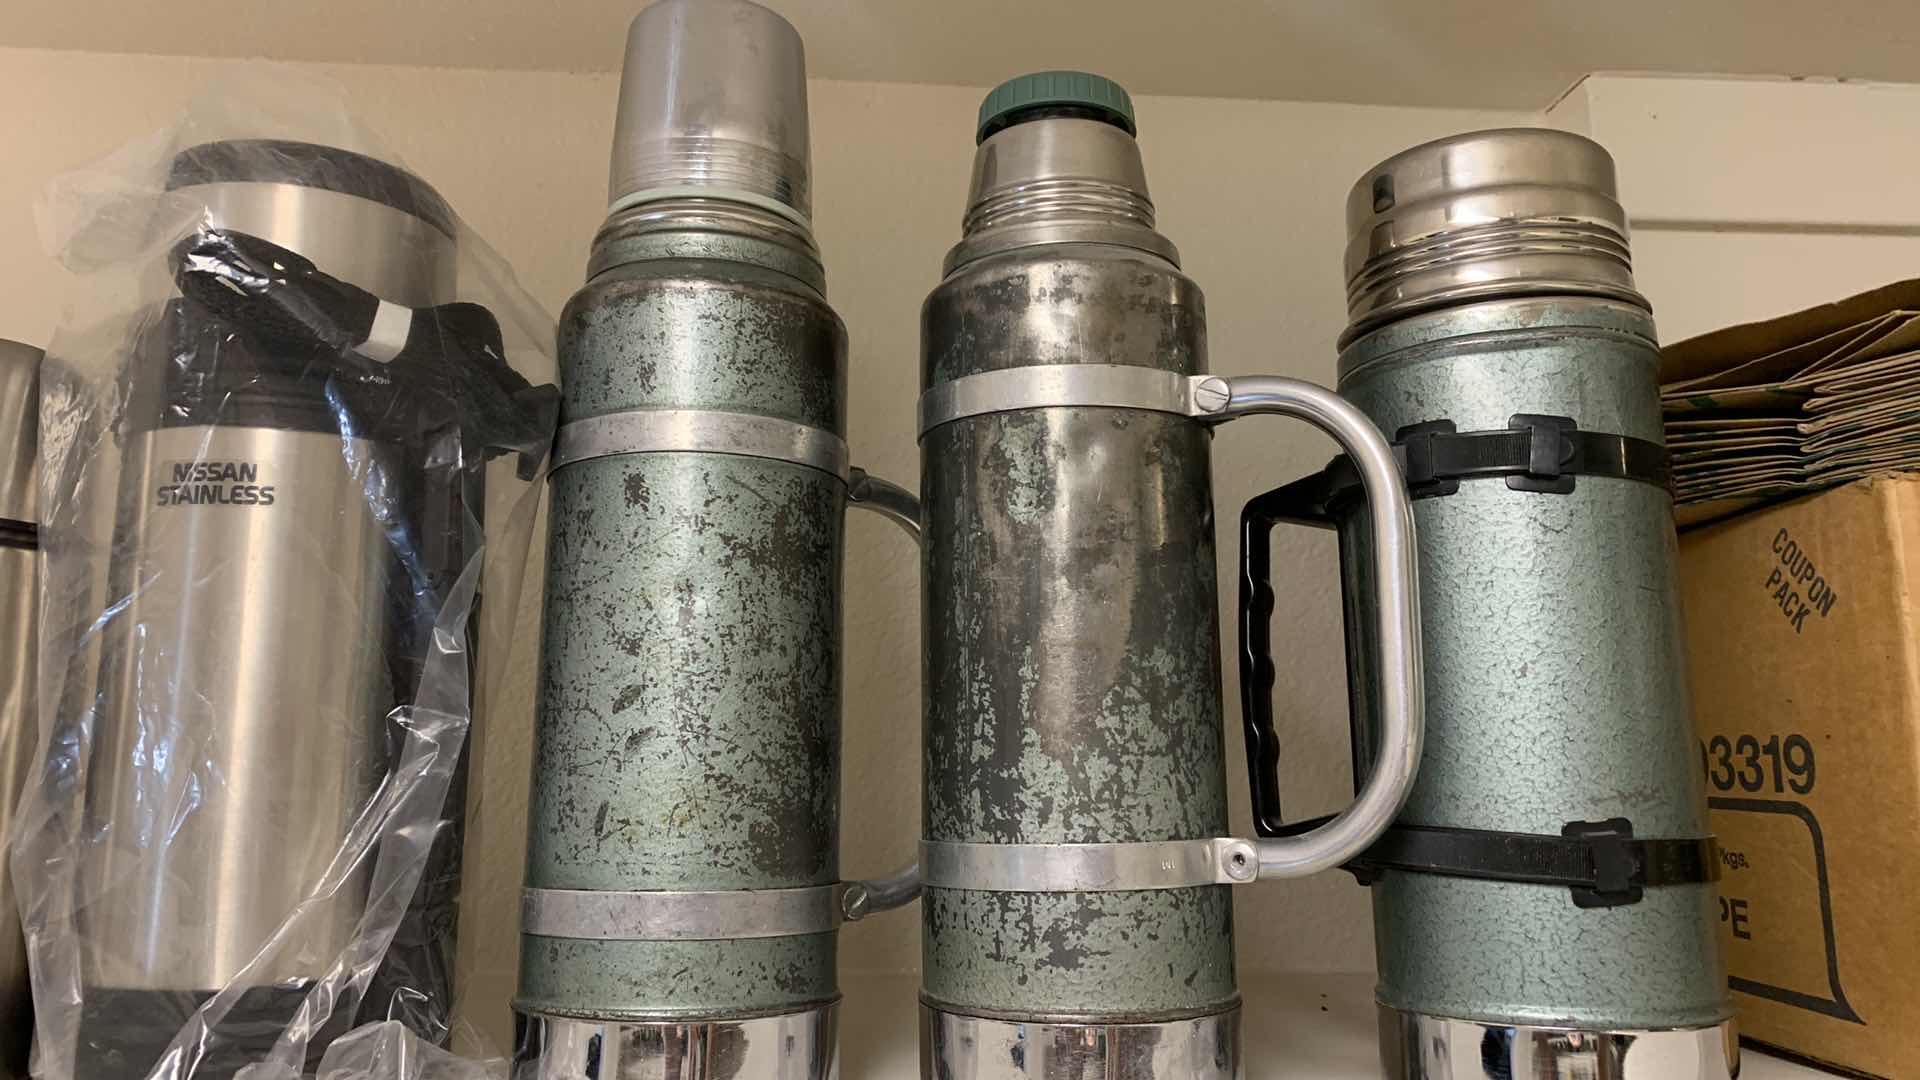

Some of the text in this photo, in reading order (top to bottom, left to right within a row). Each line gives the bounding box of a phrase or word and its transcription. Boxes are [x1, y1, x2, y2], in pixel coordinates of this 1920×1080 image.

[172, 462, 258, 483] NISSAN
[157, 484, 275, 506] STAINLESS
[1772, 527, 1837, 617] COUPON
[1765, 567, 1811, 634] PACK
[1718, 847, 1750, 870] kgs.
